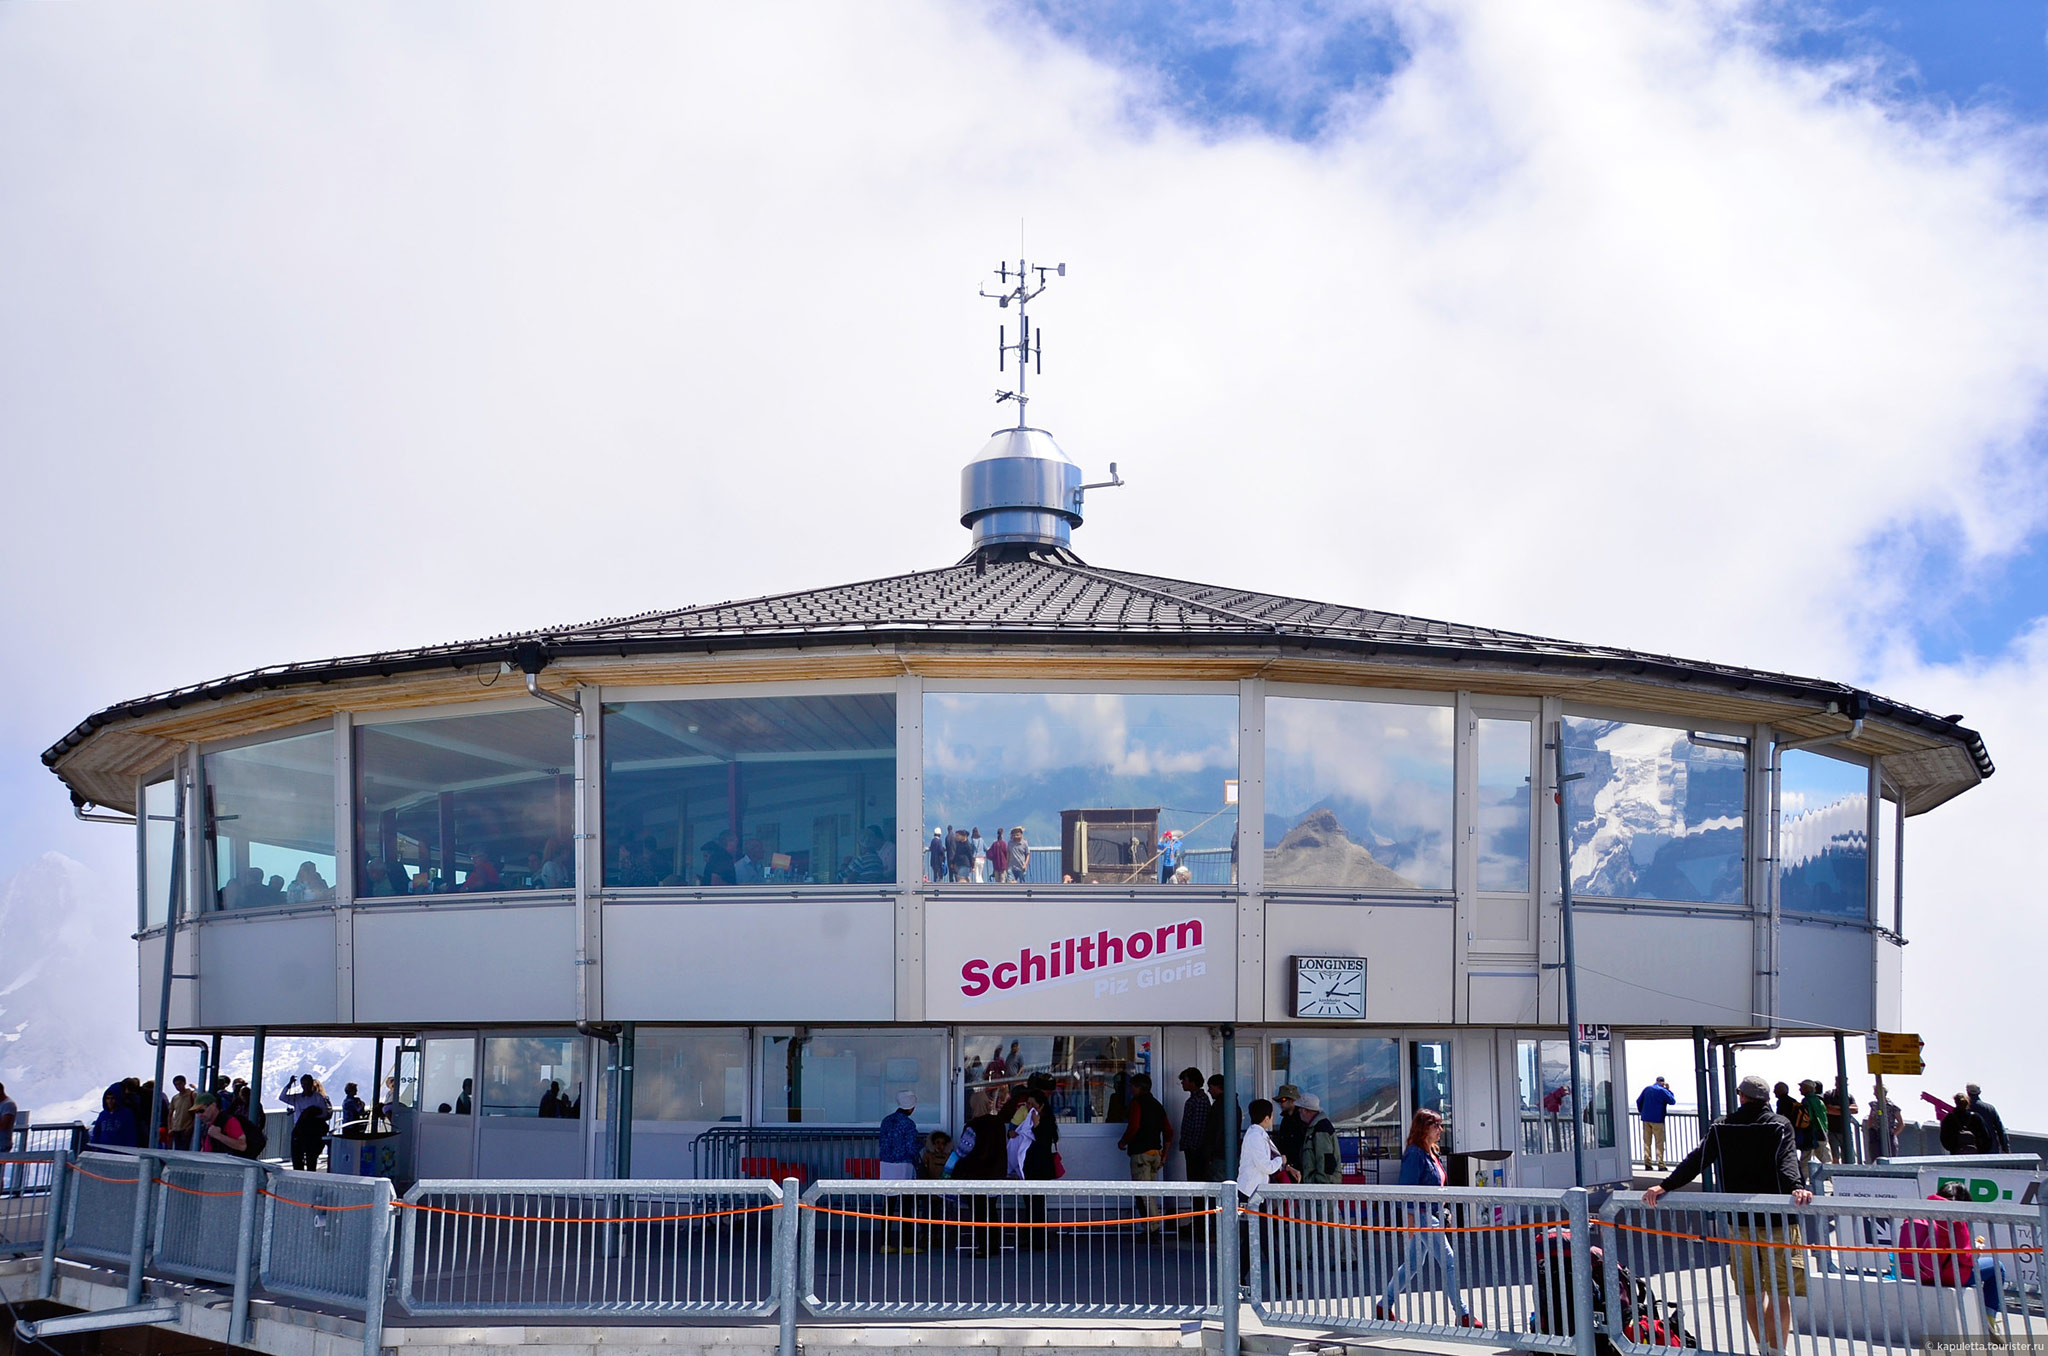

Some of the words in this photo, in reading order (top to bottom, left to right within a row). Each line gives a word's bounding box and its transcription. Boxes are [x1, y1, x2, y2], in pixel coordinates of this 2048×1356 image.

[959, 918, 1203, 998] Schilthorn
[1298, 959, 1363, 970] LONGINES
[1094, 977, 1129, 999] Piz
[1137, 959, 1207, 988] Gloria
